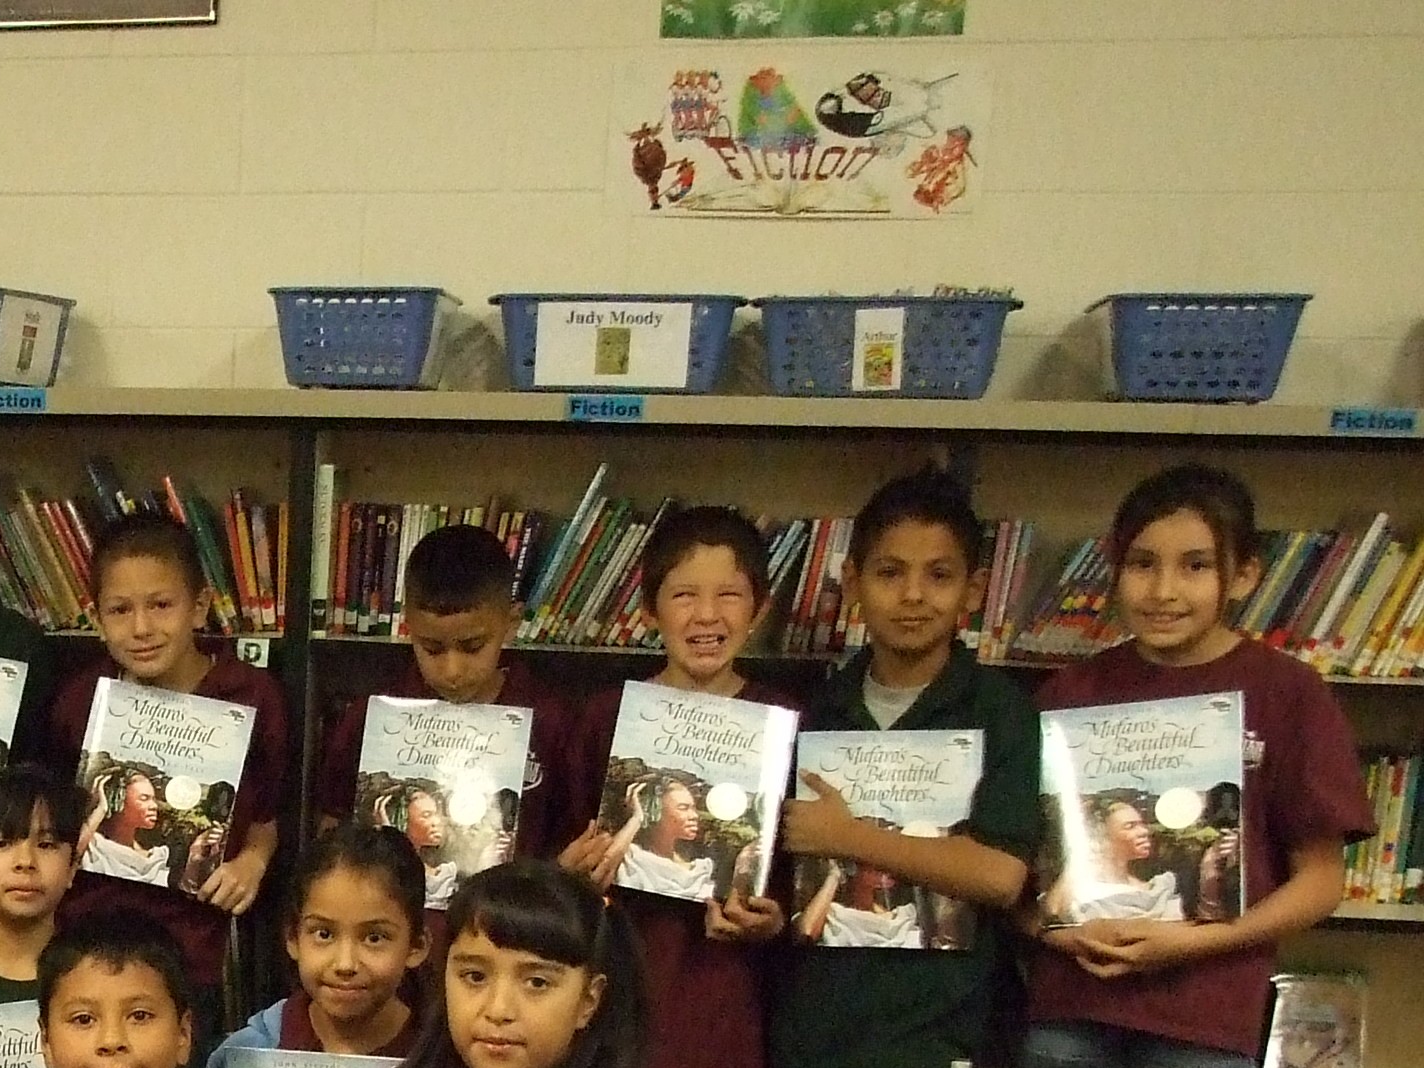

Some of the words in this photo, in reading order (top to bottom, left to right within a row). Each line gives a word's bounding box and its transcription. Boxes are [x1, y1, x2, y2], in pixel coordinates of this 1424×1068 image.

[566, 310, 604, 328] Judy
[610, 311, 663, 328] Moody
[571, 400, 640, 416] Fiction
[109, 697, 185, 722] Mufaro's
[384, 712, 464, 735] Mufaro's
[640, 700, 726, 726] Mufaro's
[128, 717, 228, 748] Beautiful
[662, 721, 764, 754] Beautiful
[1067, 717, 1157, 748] Mufaro's
[1088, 723, 1207, 755] Beautiful
[120, 730, 204, 767] Daughters
[654, 735, 746, 770] Daughters
[820, 746, 907, 772] Mufaro's
[844, 755, 950, 784] Beautiful
[1084, 754, 1193, 781] Daughters
[839, 783, 936, 812] Daughters
